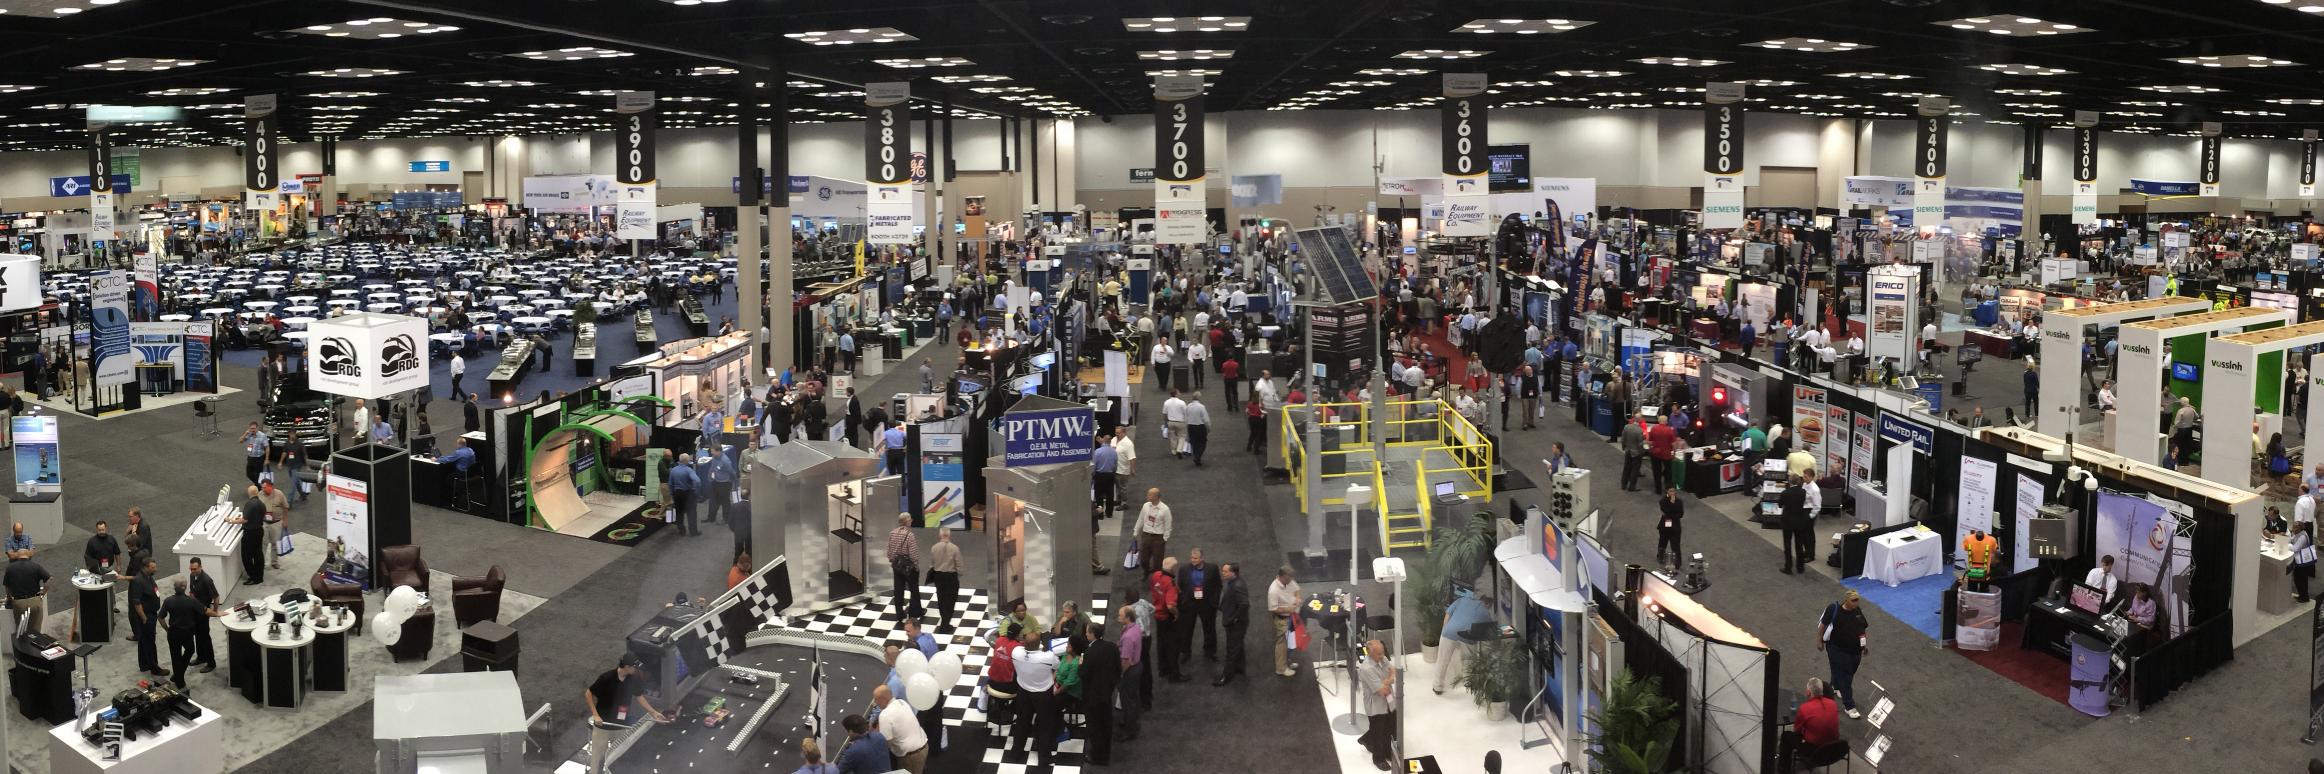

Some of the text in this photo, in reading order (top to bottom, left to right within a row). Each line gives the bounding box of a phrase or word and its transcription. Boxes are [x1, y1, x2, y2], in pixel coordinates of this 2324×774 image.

[1173, 103, 1188, 178] 3700
[1457, 100, 1471, 173] 3600
[1718, 107, 1731, 172] 3500
[629, 116, 642, 181] 3900
[880, 109, 895, 181] 3800
[1926, 118, 1937, 176] 3400
[95, 133, 104, 190] 4100
[256, 120, 267, 188] 4000
[2082, 129, 2090, 180] 3300
[1448, 212, 1485, 220] EQUIPMENT
[1450, 204, 1478, 212] RAILWAY
[100, 276, 121, 289] CTC
[1874, 282, 1904, 290] ERICO
[190, 325, 208, 333] CTC
[2122, 344, 2150, 355] vossloh
[338, 364, 361, 377] RDG
[399, 357, 419, 372] RDG
[2211, 359, 2242, 371] vossloh
[1796, 387, 1825, 403] UTE
[1829, 407, 1847, 422] UTE
[1007, 416, 1087, 441] PTMW
[1856, 416, 1873, 433] UTE
[1884, 420, 1929, 445] UNITED RAIL
[1007, 451, 1045, 460] FABRICATION
[1061, 448, 1092, 456] ASSEMBLY
